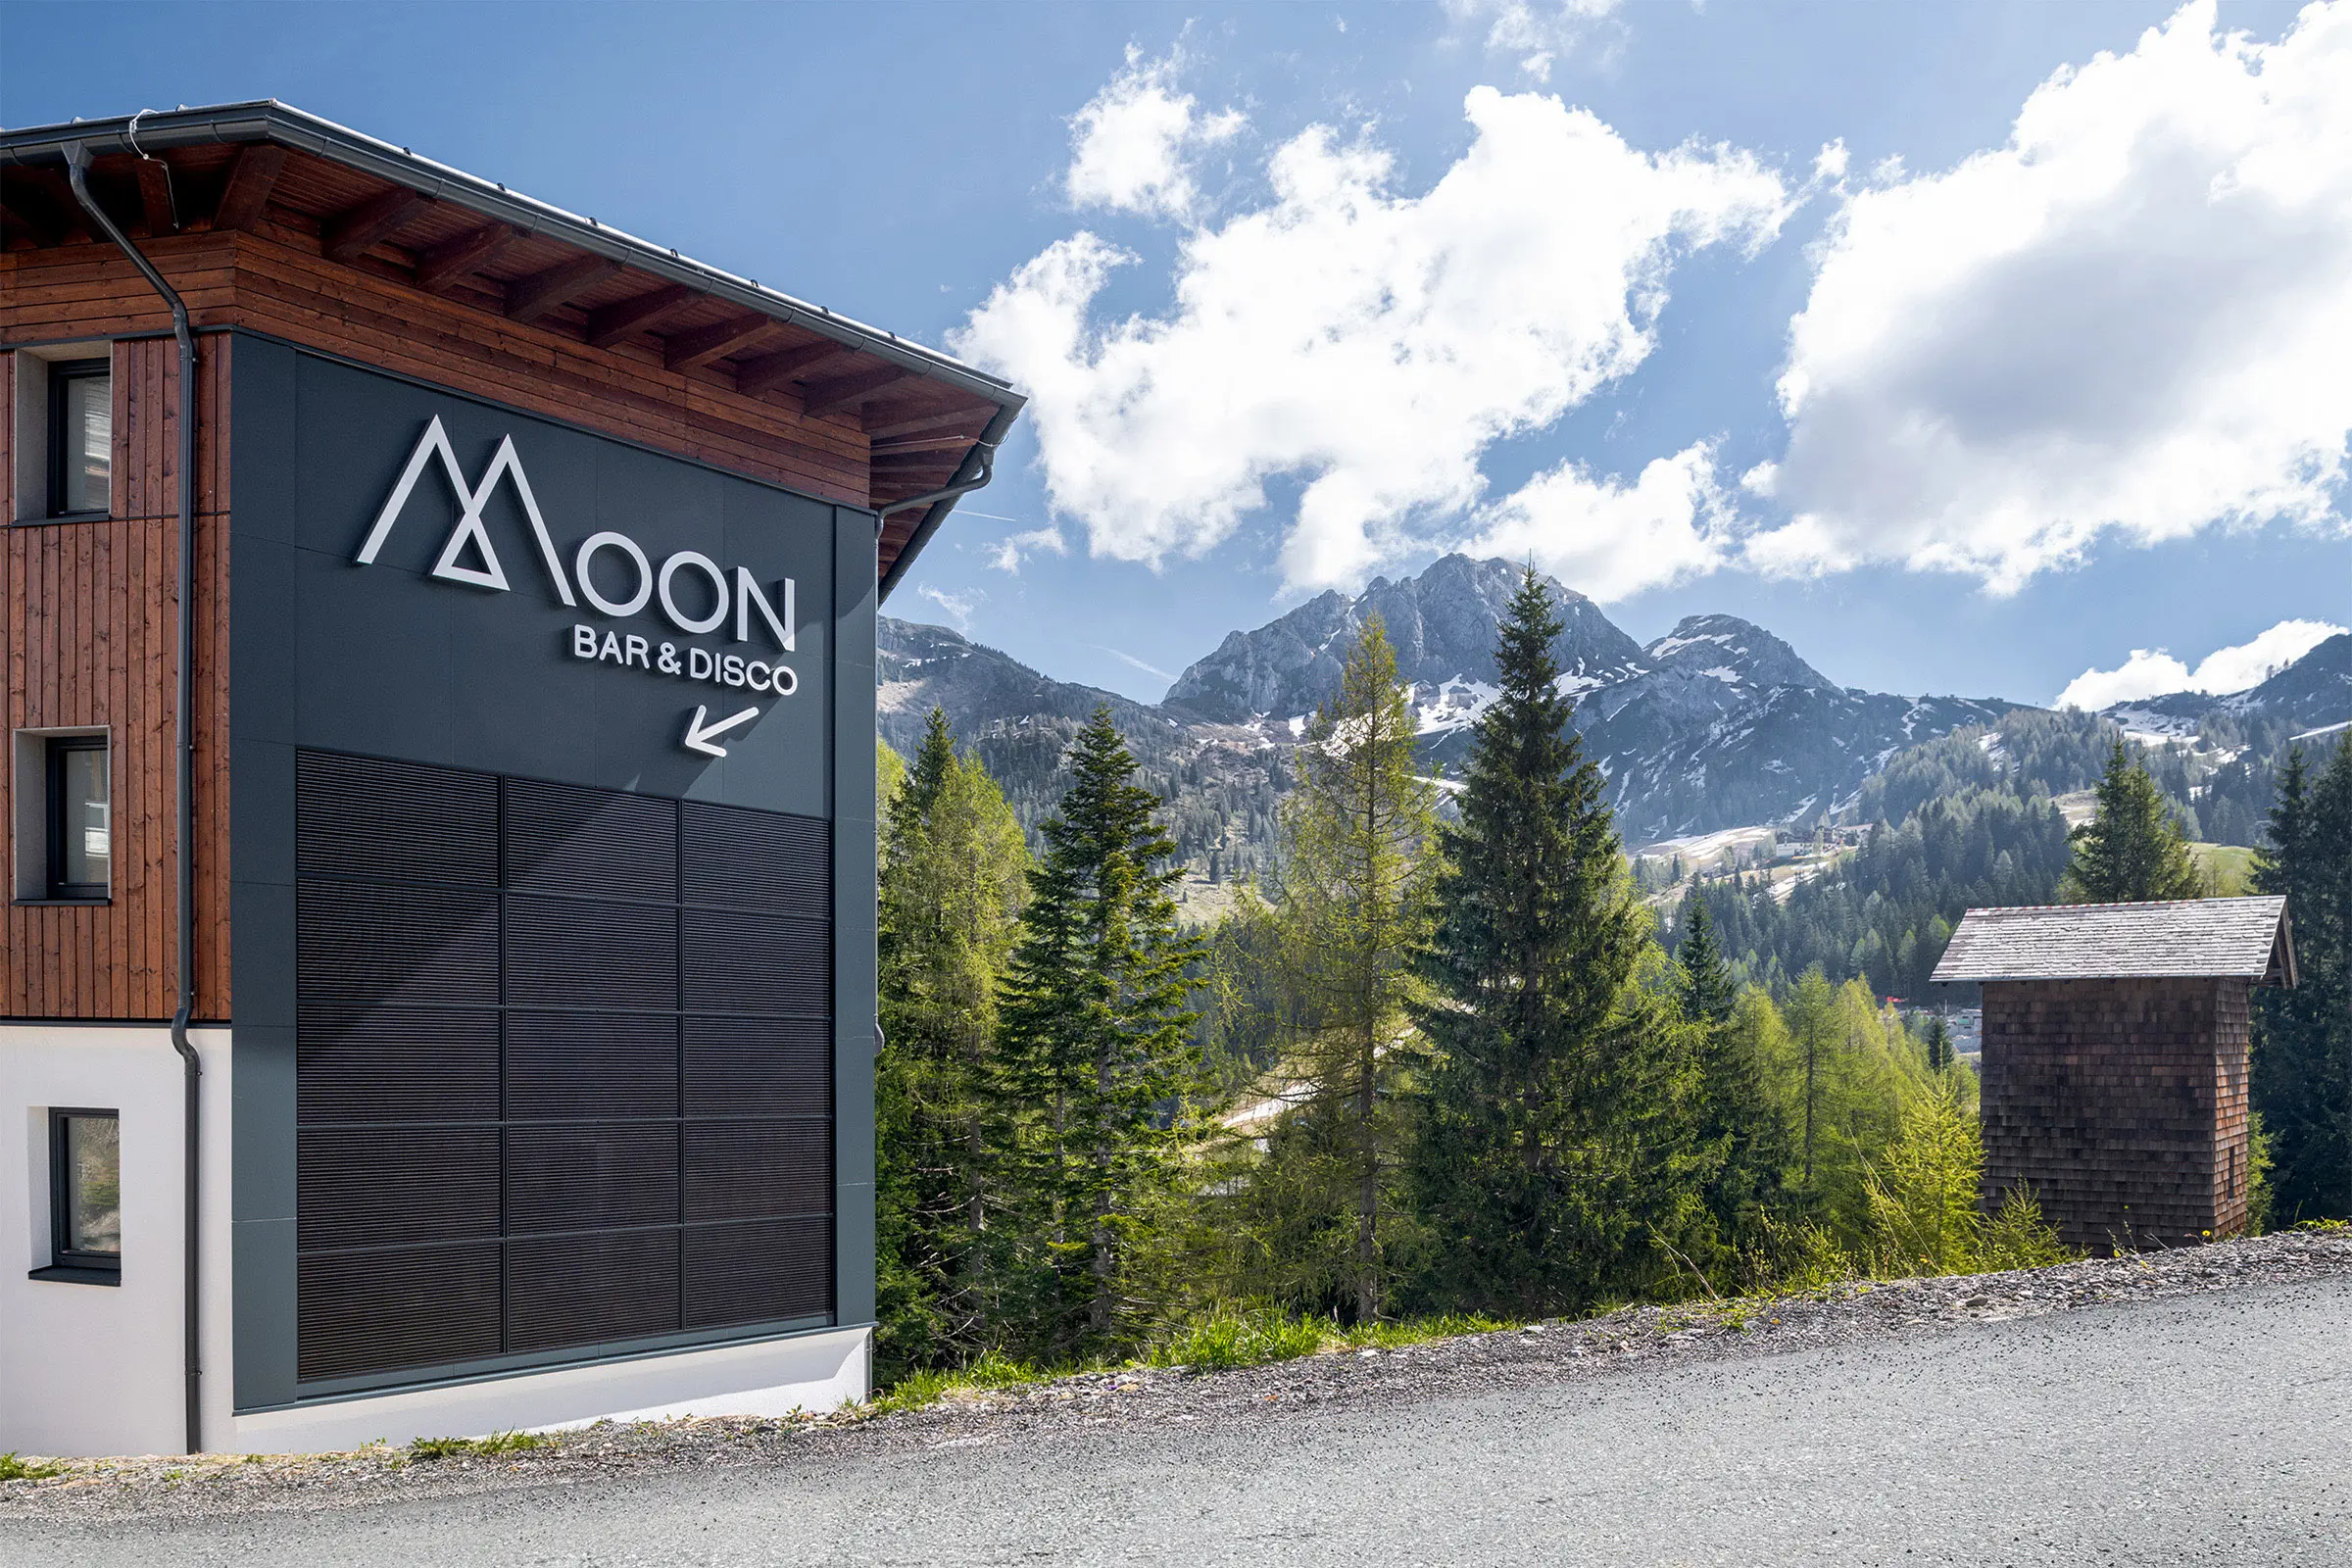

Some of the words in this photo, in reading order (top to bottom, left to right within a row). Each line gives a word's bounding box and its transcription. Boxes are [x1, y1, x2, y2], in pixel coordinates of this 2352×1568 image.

[357, 414, 796, 653] MOON
[574, 623, 651, 669] BAR
[658, 642, 682, 675] &
[690, 647, 799, 697] DISCO
